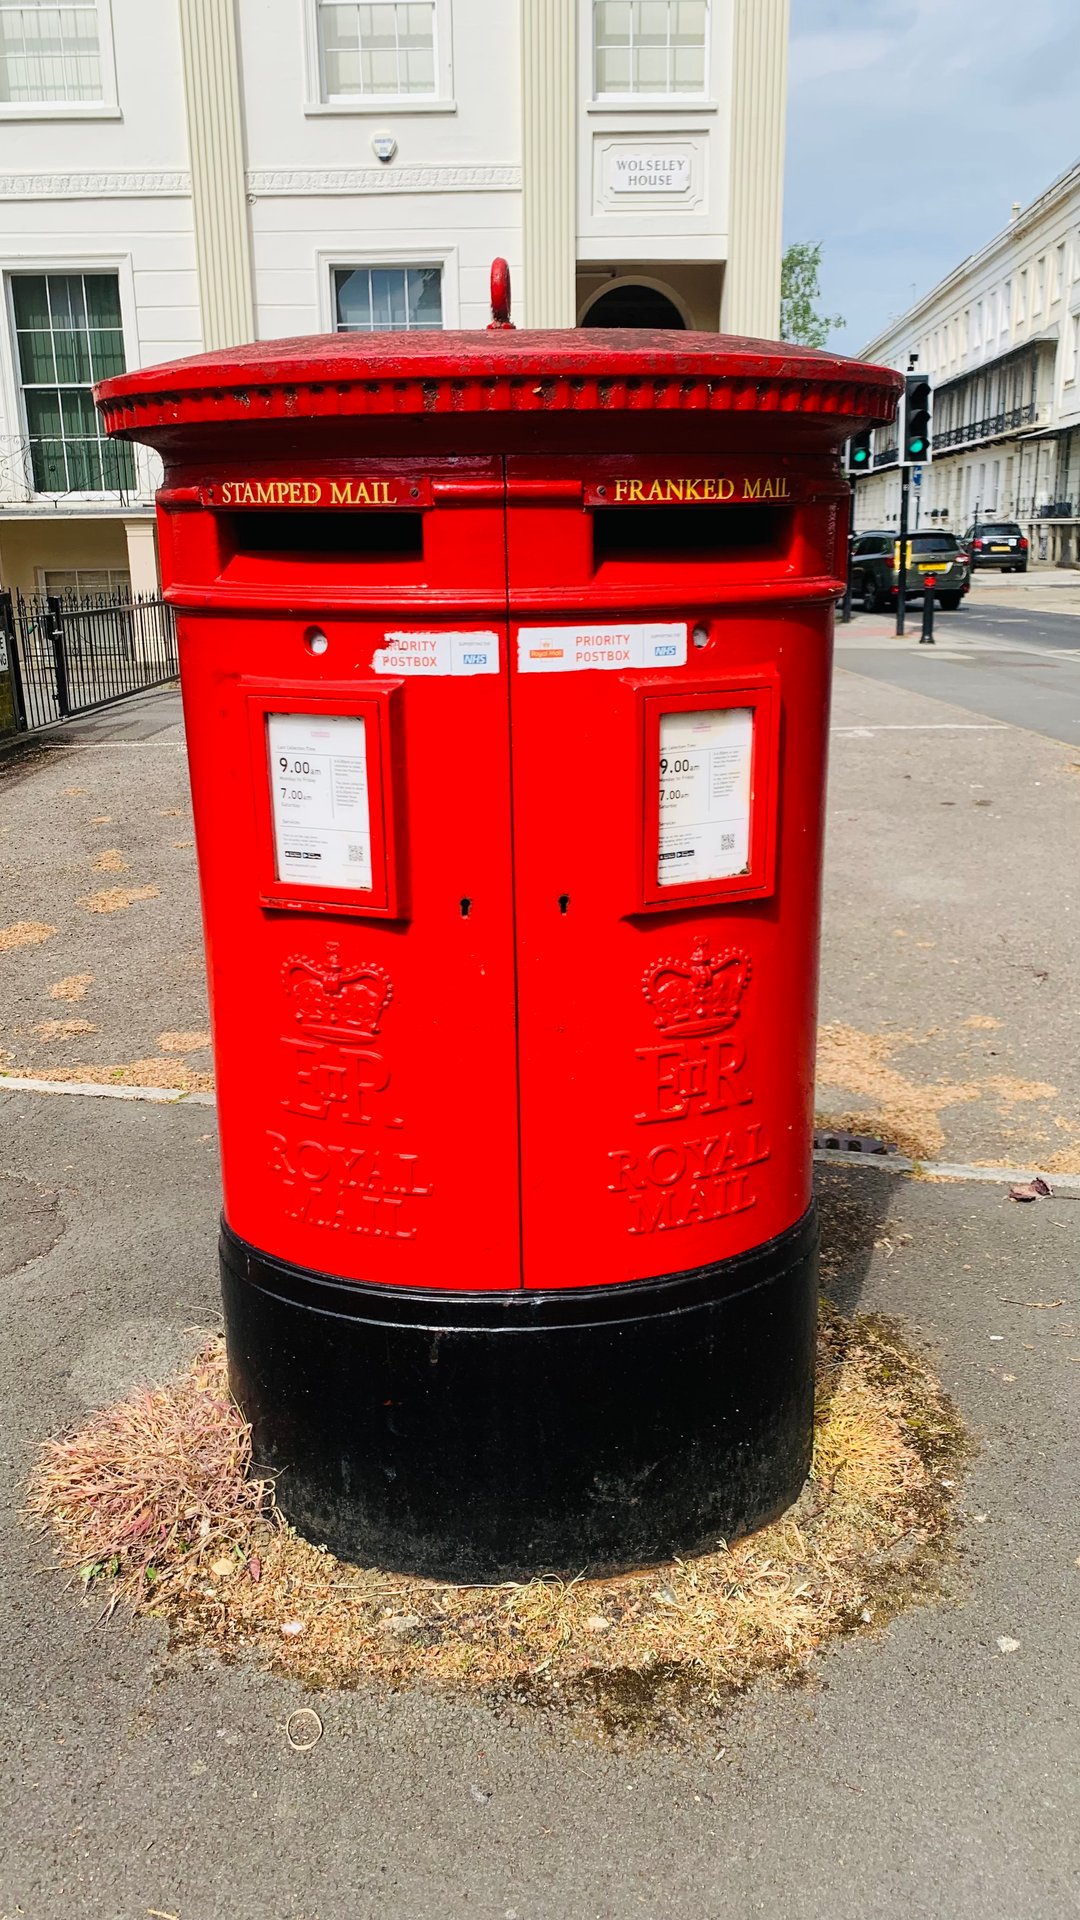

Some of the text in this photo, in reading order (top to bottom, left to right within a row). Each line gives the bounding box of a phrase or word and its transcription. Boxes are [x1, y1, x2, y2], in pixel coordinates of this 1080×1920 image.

[616, 160, 685, 171] WOLSELEY
[628, 175, 672, 186] HOUSE
[222, 482, 397, 504] STAMPED MAIL
[614, 478, 791, 501] FRANKED MAIL
[389, 640, 437, 651] RIORITY
[575, 634, 630, 647] PRIORITY
[575, 650, 630, 662] POSTBOX
[655, 646, 676, 656] NHS
[382, 656, 437, 667] POSTBOX
[464, 654, 487, 664] NHS
[266, 1129, 434, 1196] ROYAL
[607, 1123, 770, 1192] ROYAL
[283, 1178, 417, 1240] MAIL
[628, 1172, 757, 1235] MAIL
